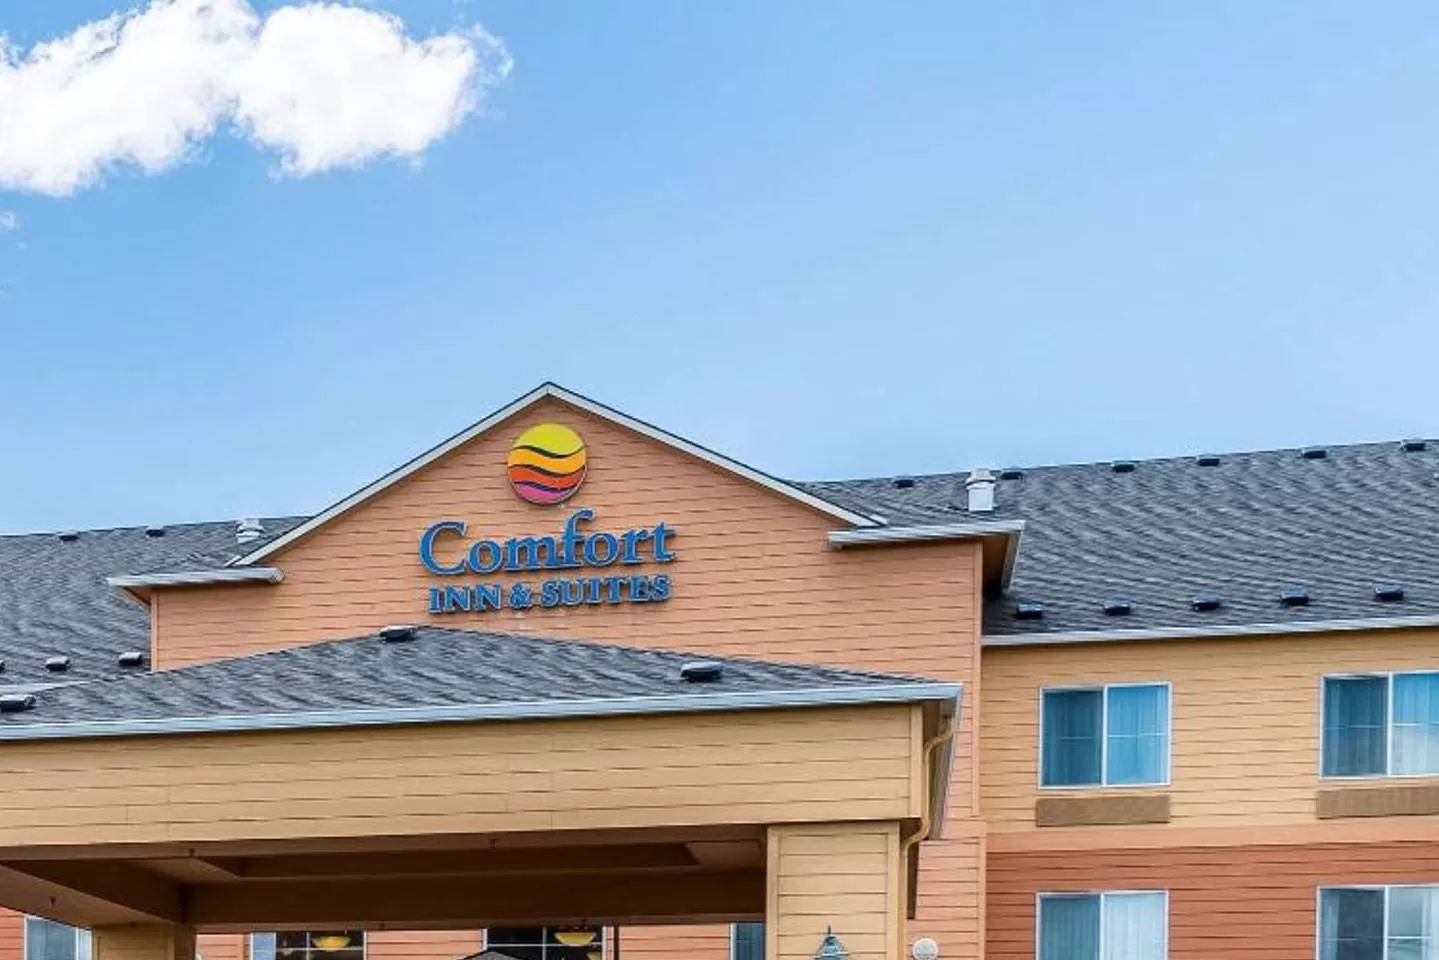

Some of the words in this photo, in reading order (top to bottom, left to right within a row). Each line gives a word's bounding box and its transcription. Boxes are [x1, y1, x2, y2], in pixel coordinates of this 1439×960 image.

[419, 508, 676, 576] Comfort
[428, 584, 502, 613] INN
[509, 583, 533, 609] &
[539, 575, 671, 607] SUITES
